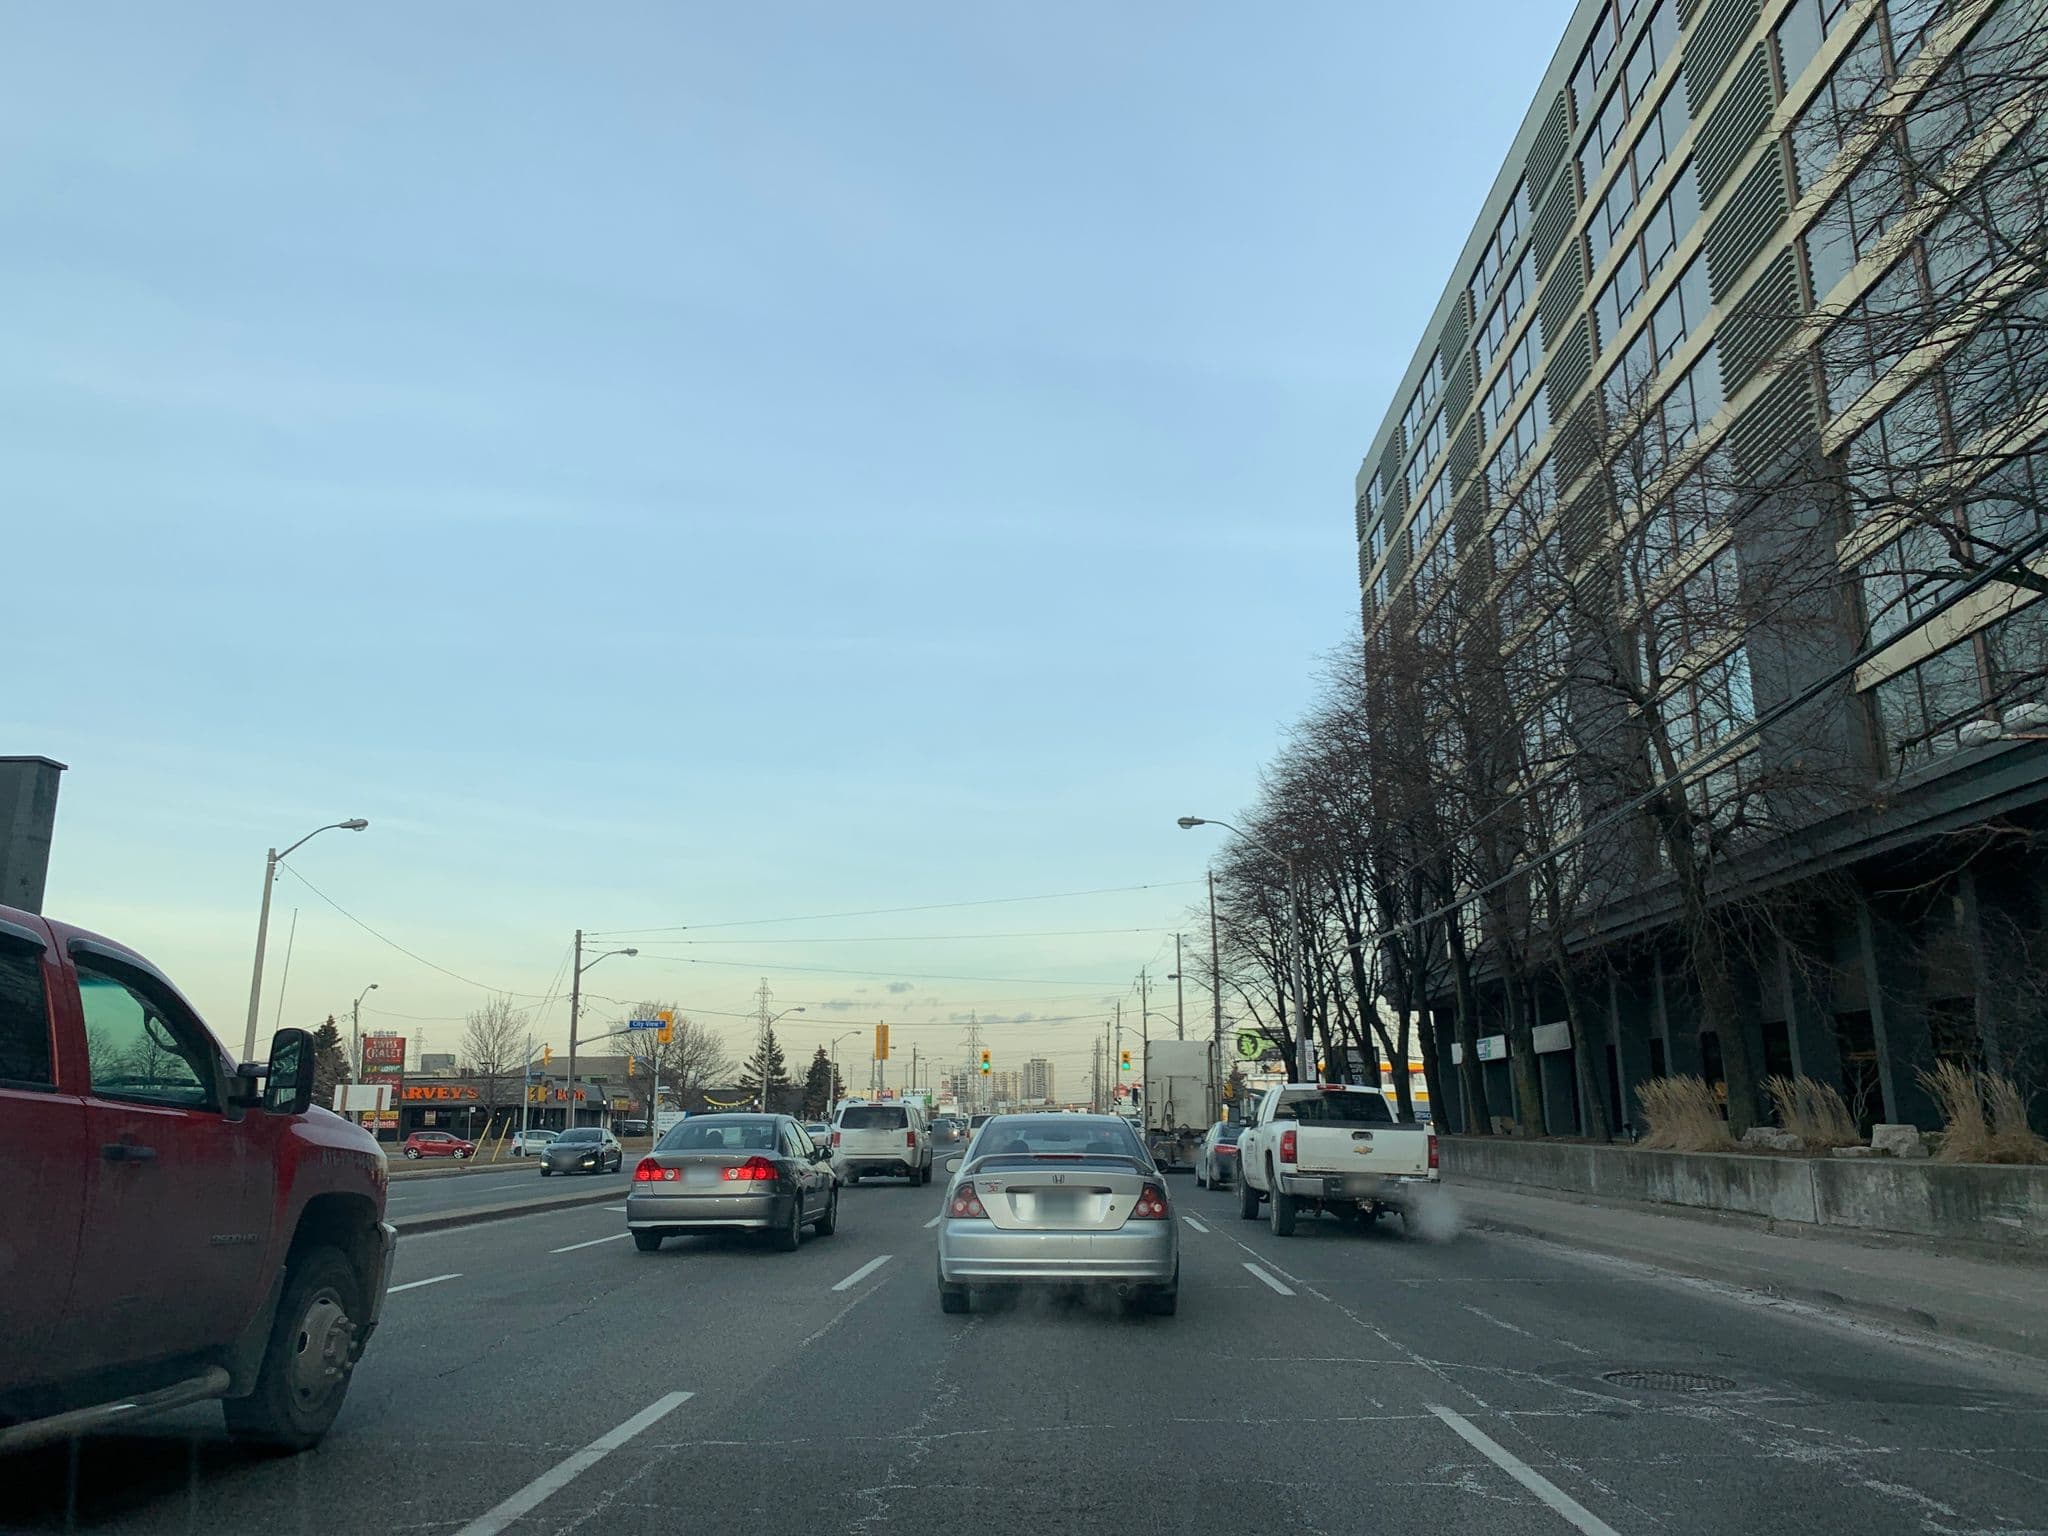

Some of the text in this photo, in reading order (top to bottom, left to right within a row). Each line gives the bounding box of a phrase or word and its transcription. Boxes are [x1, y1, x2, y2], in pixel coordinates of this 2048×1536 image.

[632, 1020, 645, 1029] City
[373, 1040, 398, 1049] SWISS
[366, 1047, 402, 1060] CHALET
[401, 1087, 479, 1100] ARVEY'S
